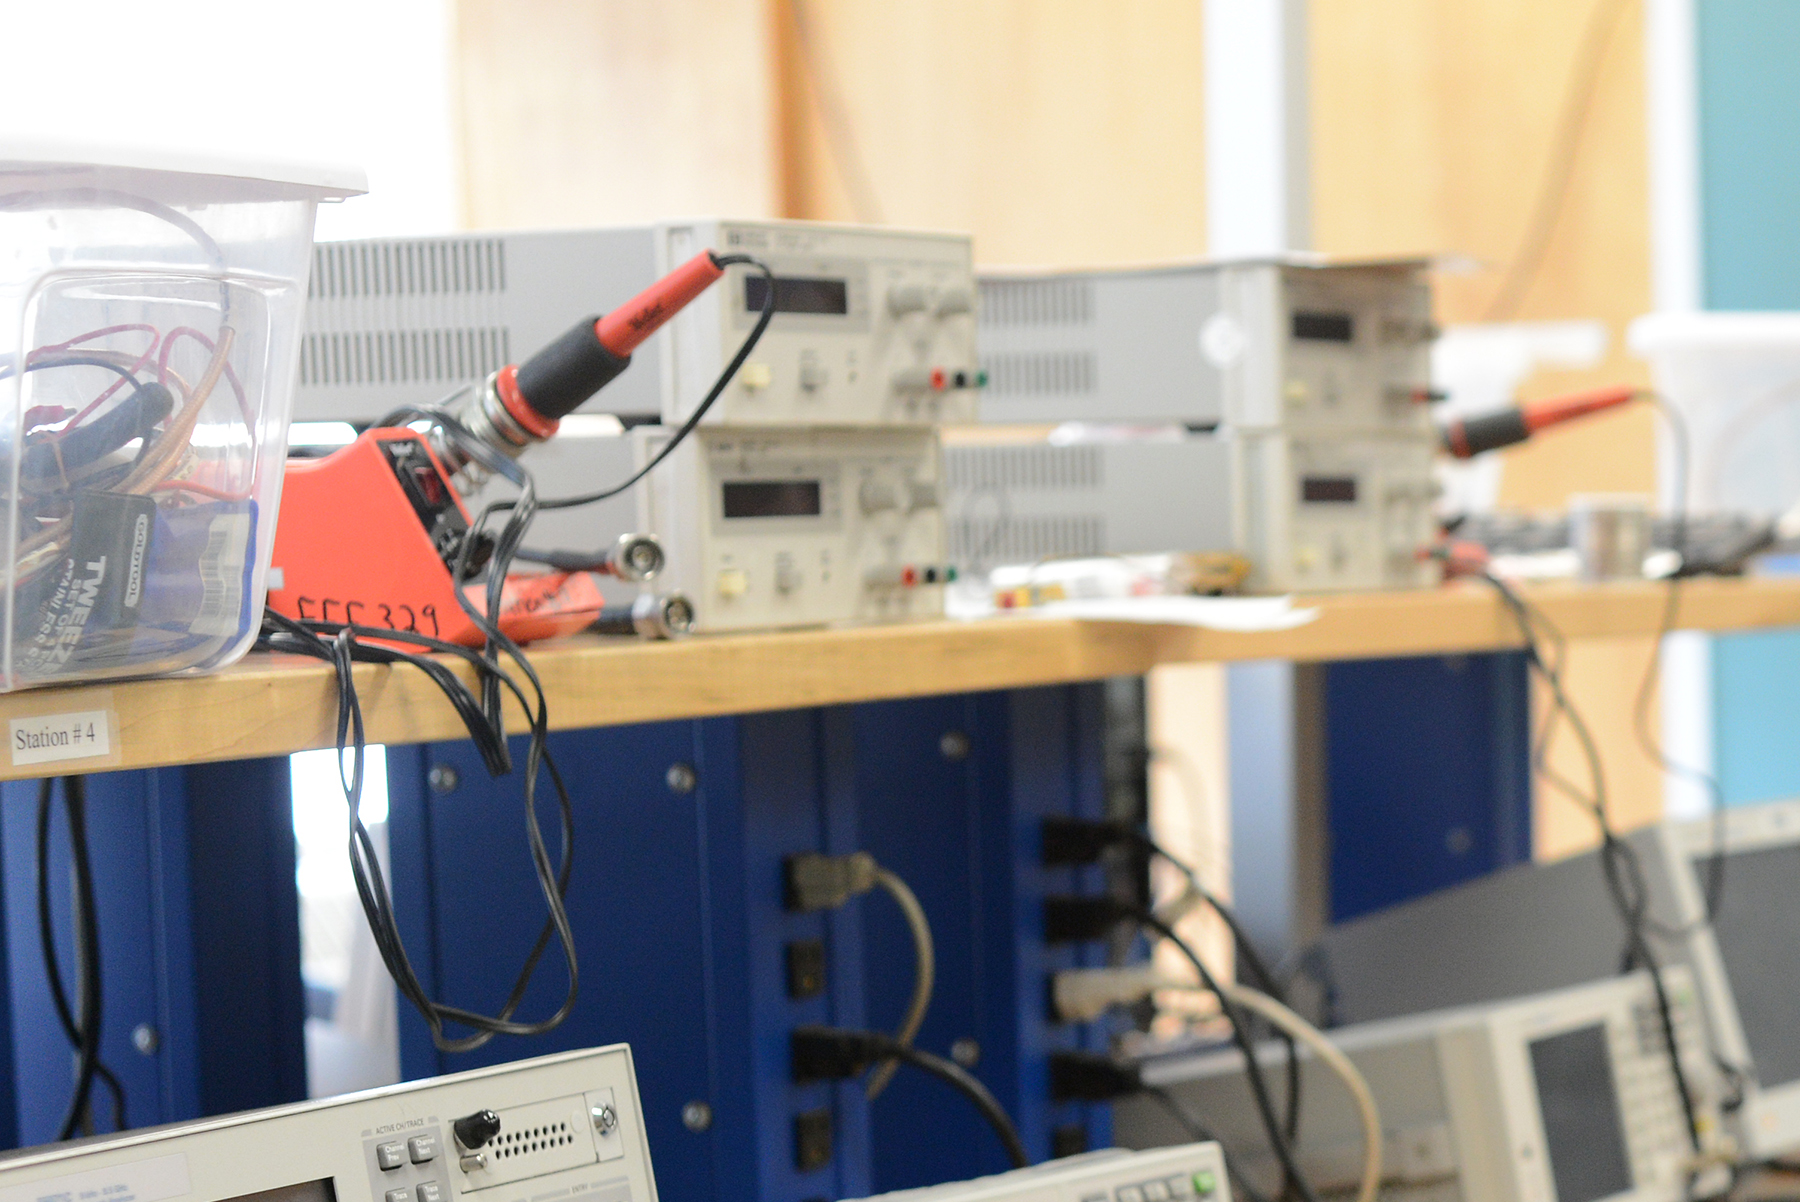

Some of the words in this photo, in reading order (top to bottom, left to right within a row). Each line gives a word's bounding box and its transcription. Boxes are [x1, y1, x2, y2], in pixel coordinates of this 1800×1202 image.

[16, 726, 69, 750] Station
[73, 723, 82, 744] #
[86, 722, 96, 742] 4
[375, 1123, 396, 1135] ACTIVE
[415, 1136, 436, 1147] Channel
[384, 1142, 405, 1154] Channel
[424, 1184, 439, 1194] Trace
[571, 1183, 589, 1193] ENTRY
[393, 1190, 408, 1200] Trace
